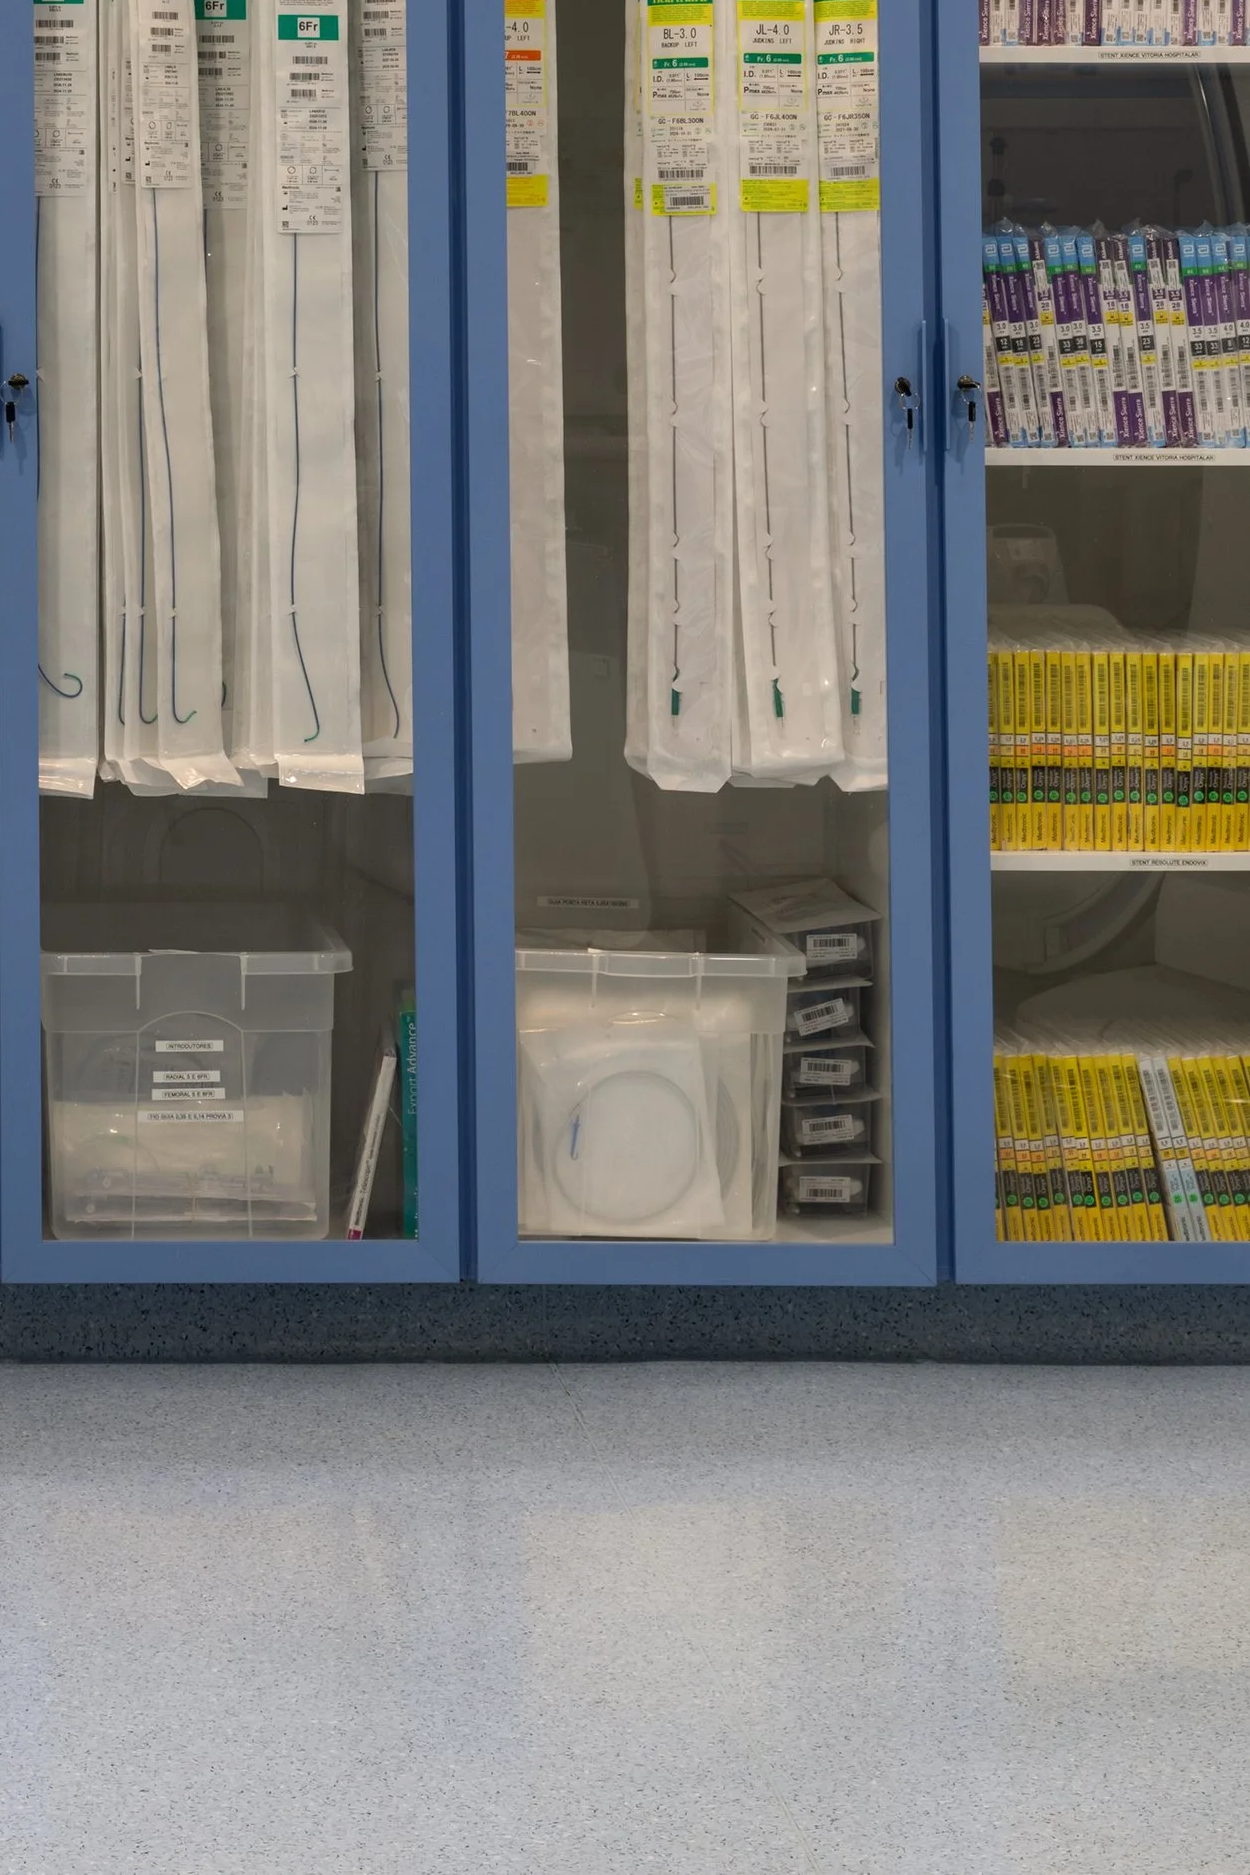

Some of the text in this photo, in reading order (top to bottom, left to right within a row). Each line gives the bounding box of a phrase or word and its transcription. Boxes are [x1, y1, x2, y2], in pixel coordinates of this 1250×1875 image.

[205, 1, 225, 11] 6Fr
[298, 21, 319, 32] 6Fr
[756, 24, 790, 35] JL-4.0
[829, 23, 863, 36] JR-3.5
[663, 28, 697, 39] BL-3.0
[766, 54, 772, 62] 6
[838, 54, 844, 62] 6
